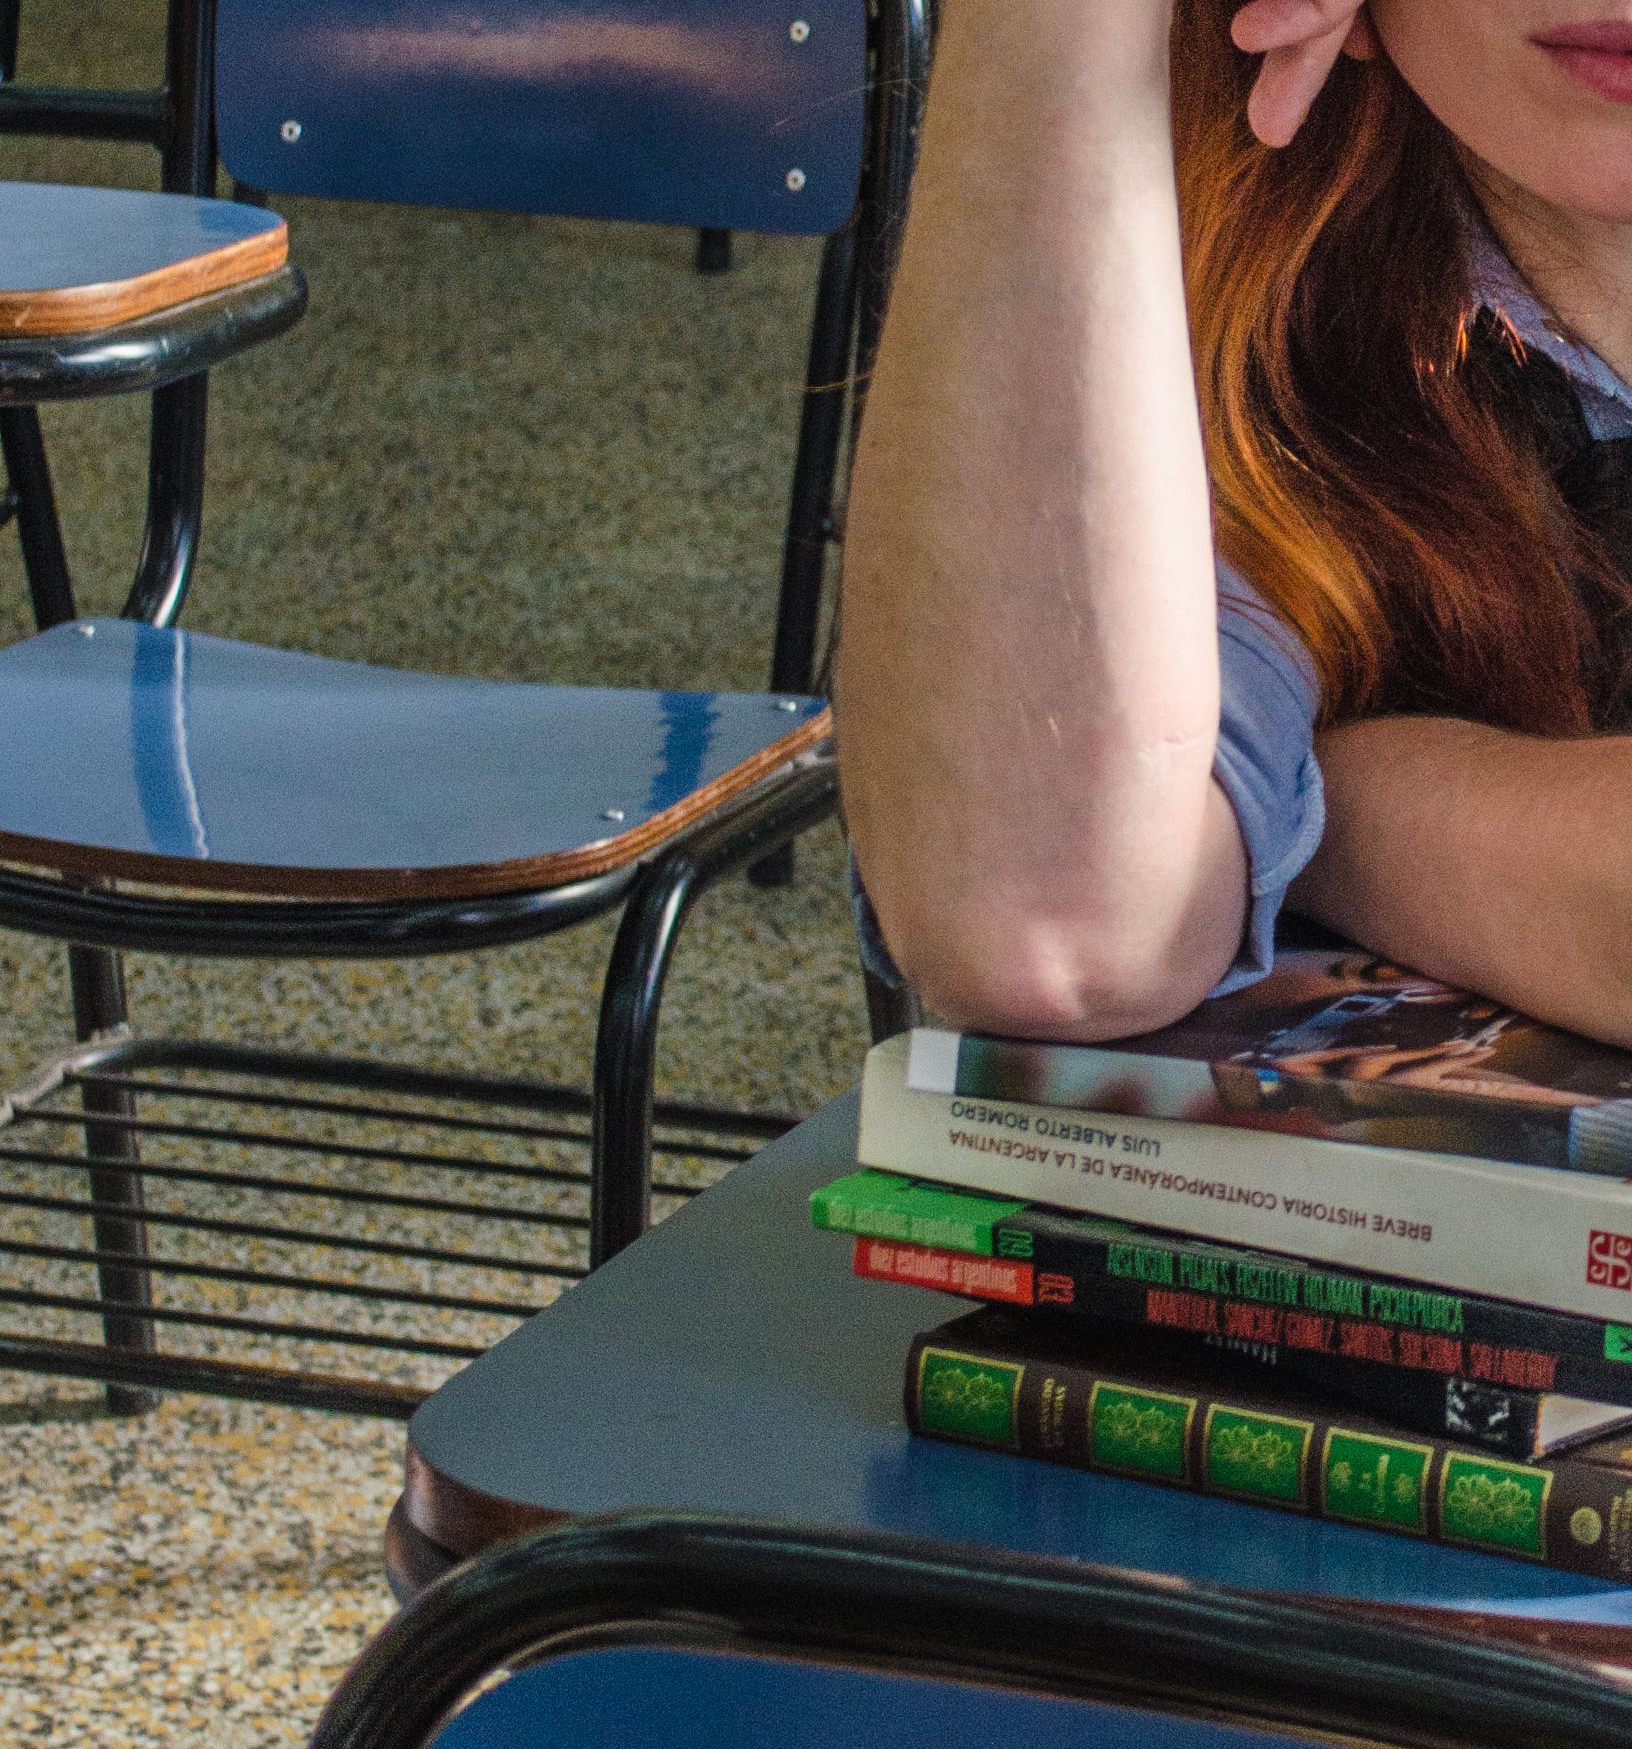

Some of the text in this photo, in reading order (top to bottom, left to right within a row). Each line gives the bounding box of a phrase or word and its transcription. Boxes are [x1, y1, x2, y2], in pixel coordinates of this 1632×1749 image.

[950, 1100, 1161, 1158] LUIS ALBERTO ROMERO
[950, 1129, 1433, 1242] BREVE HISTORIA CONTEMPORÁNEA DE LA ARGENTINA
